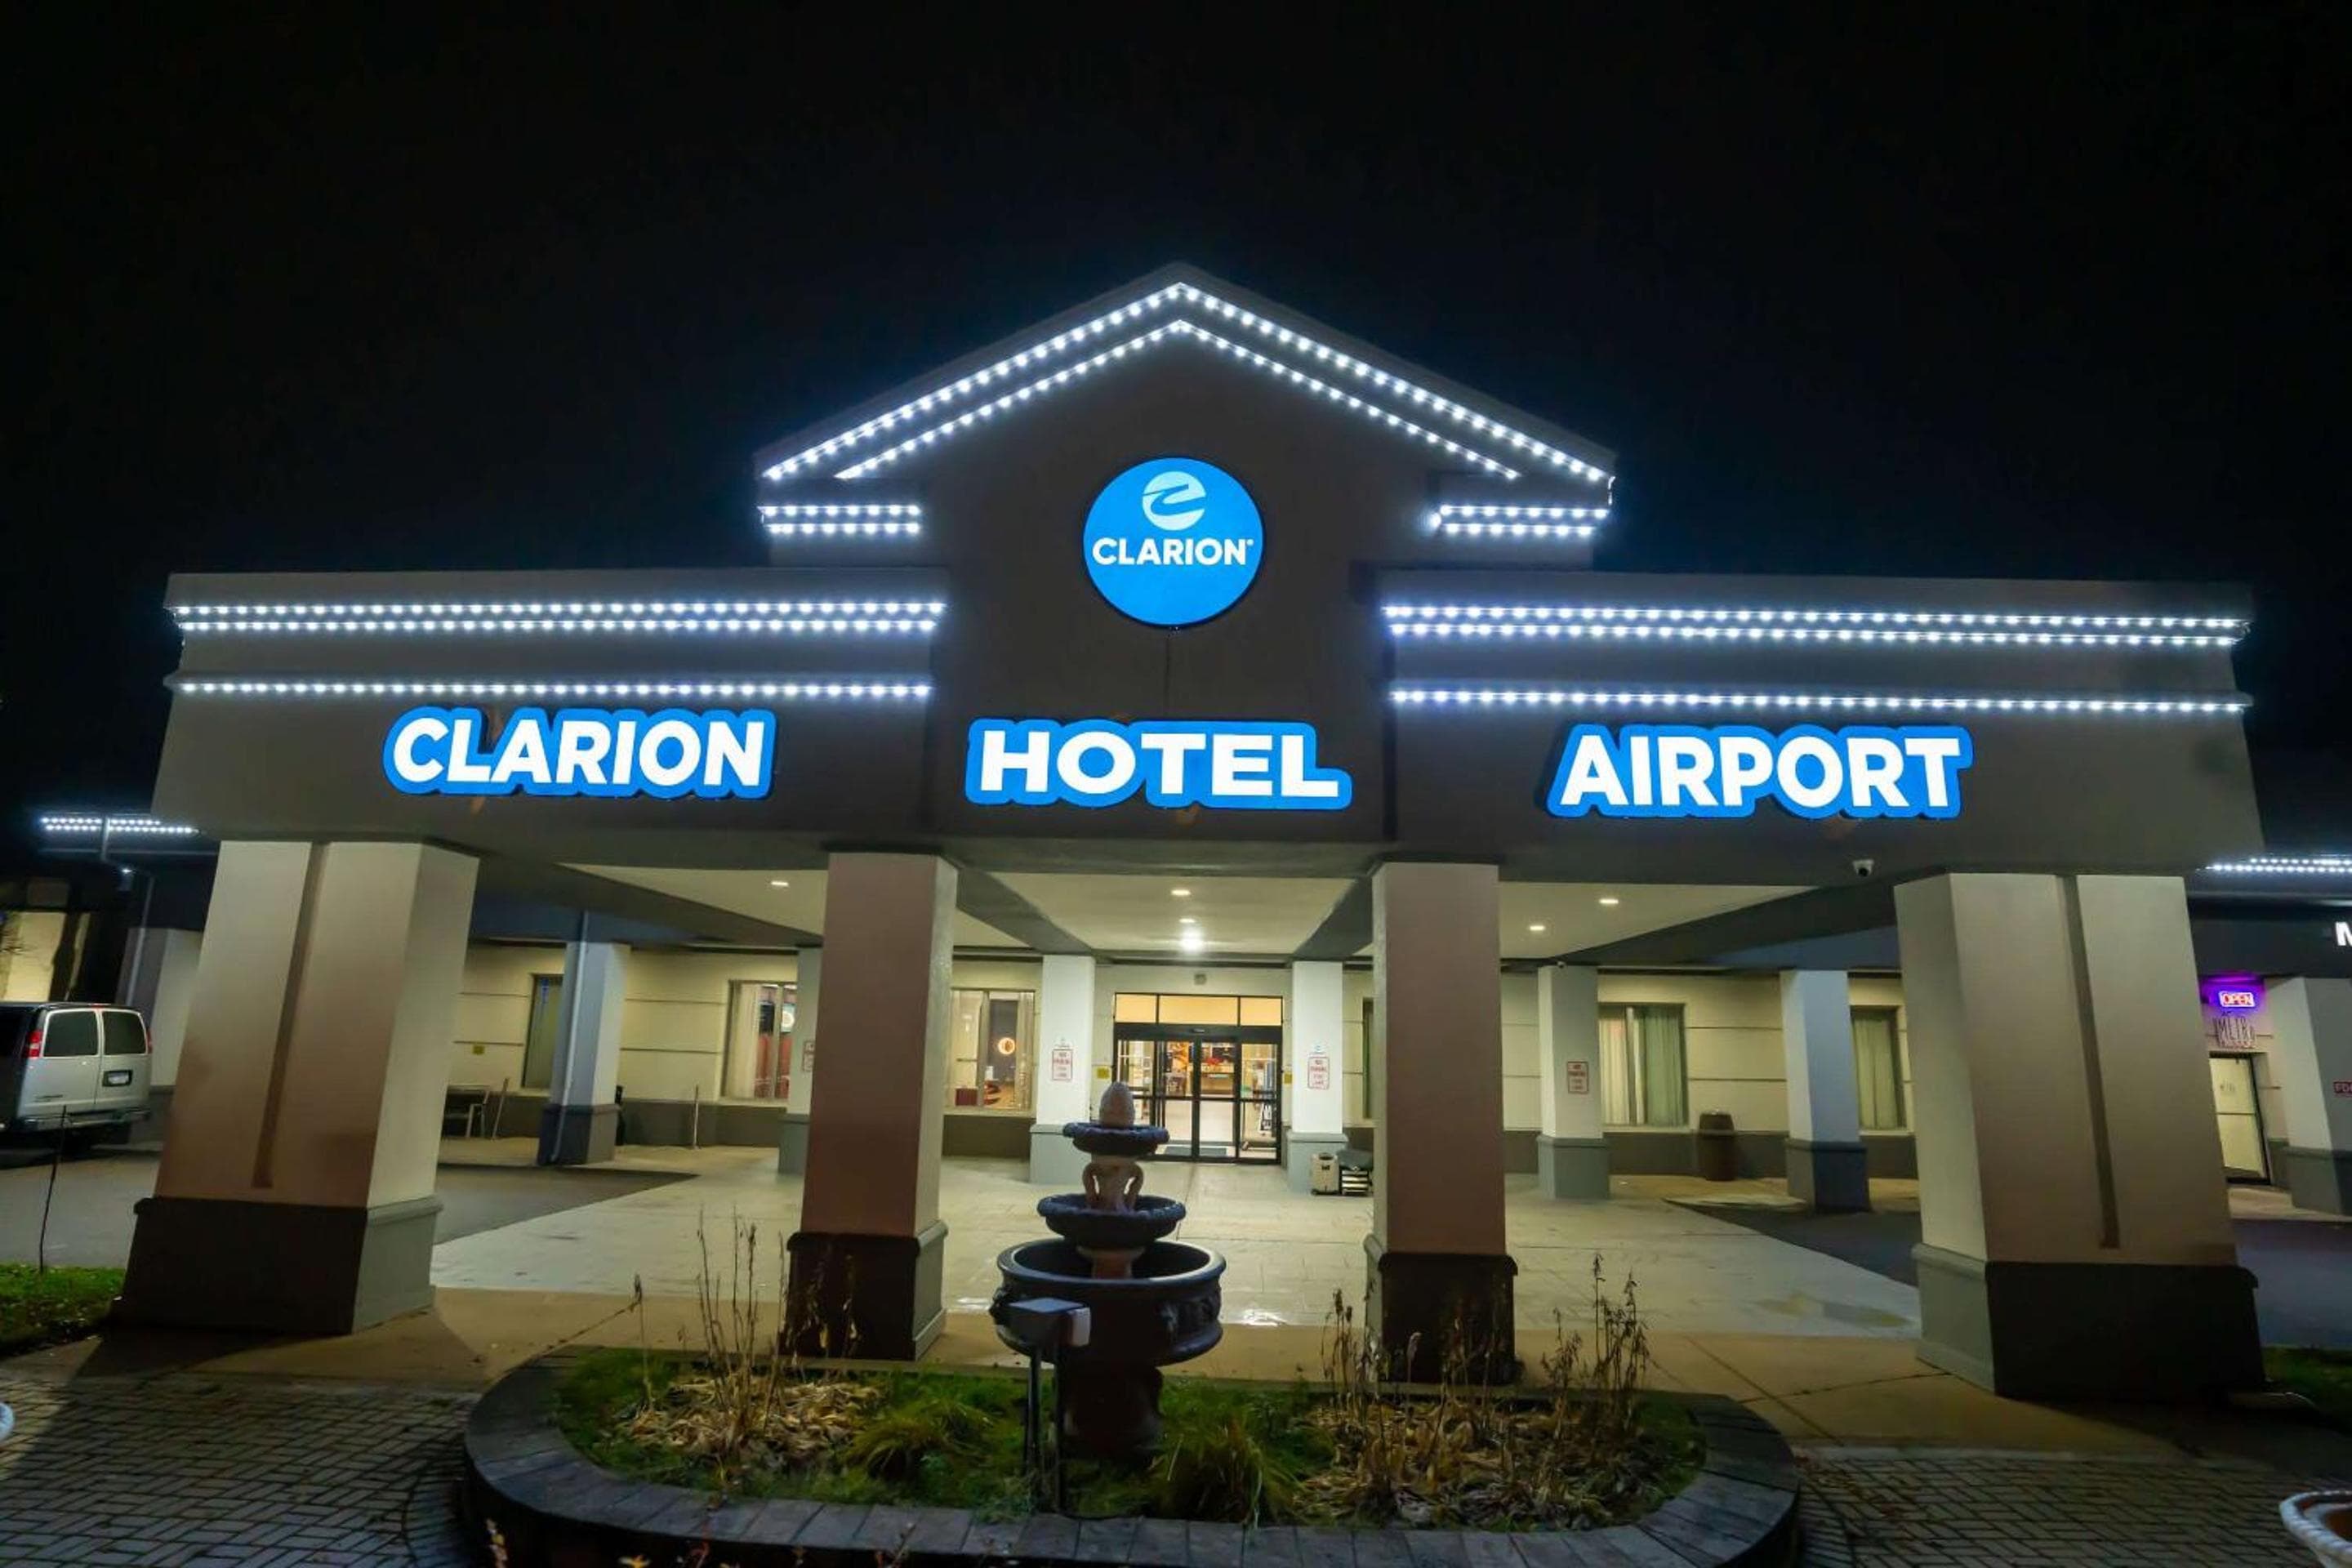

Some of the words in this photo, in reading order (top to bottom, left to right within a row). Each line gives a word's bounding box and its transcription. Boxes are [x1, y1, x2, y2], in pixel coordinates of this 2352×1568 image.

[1093, 538, 1246, 565] CLARION
[394, 717, 764, 786] CLARION
[981, 730, 1339, 797] HOTEL
[1560, 735, 1960, 808] AIRPORT
[2223, 993, 2252, 1004] OPEN
